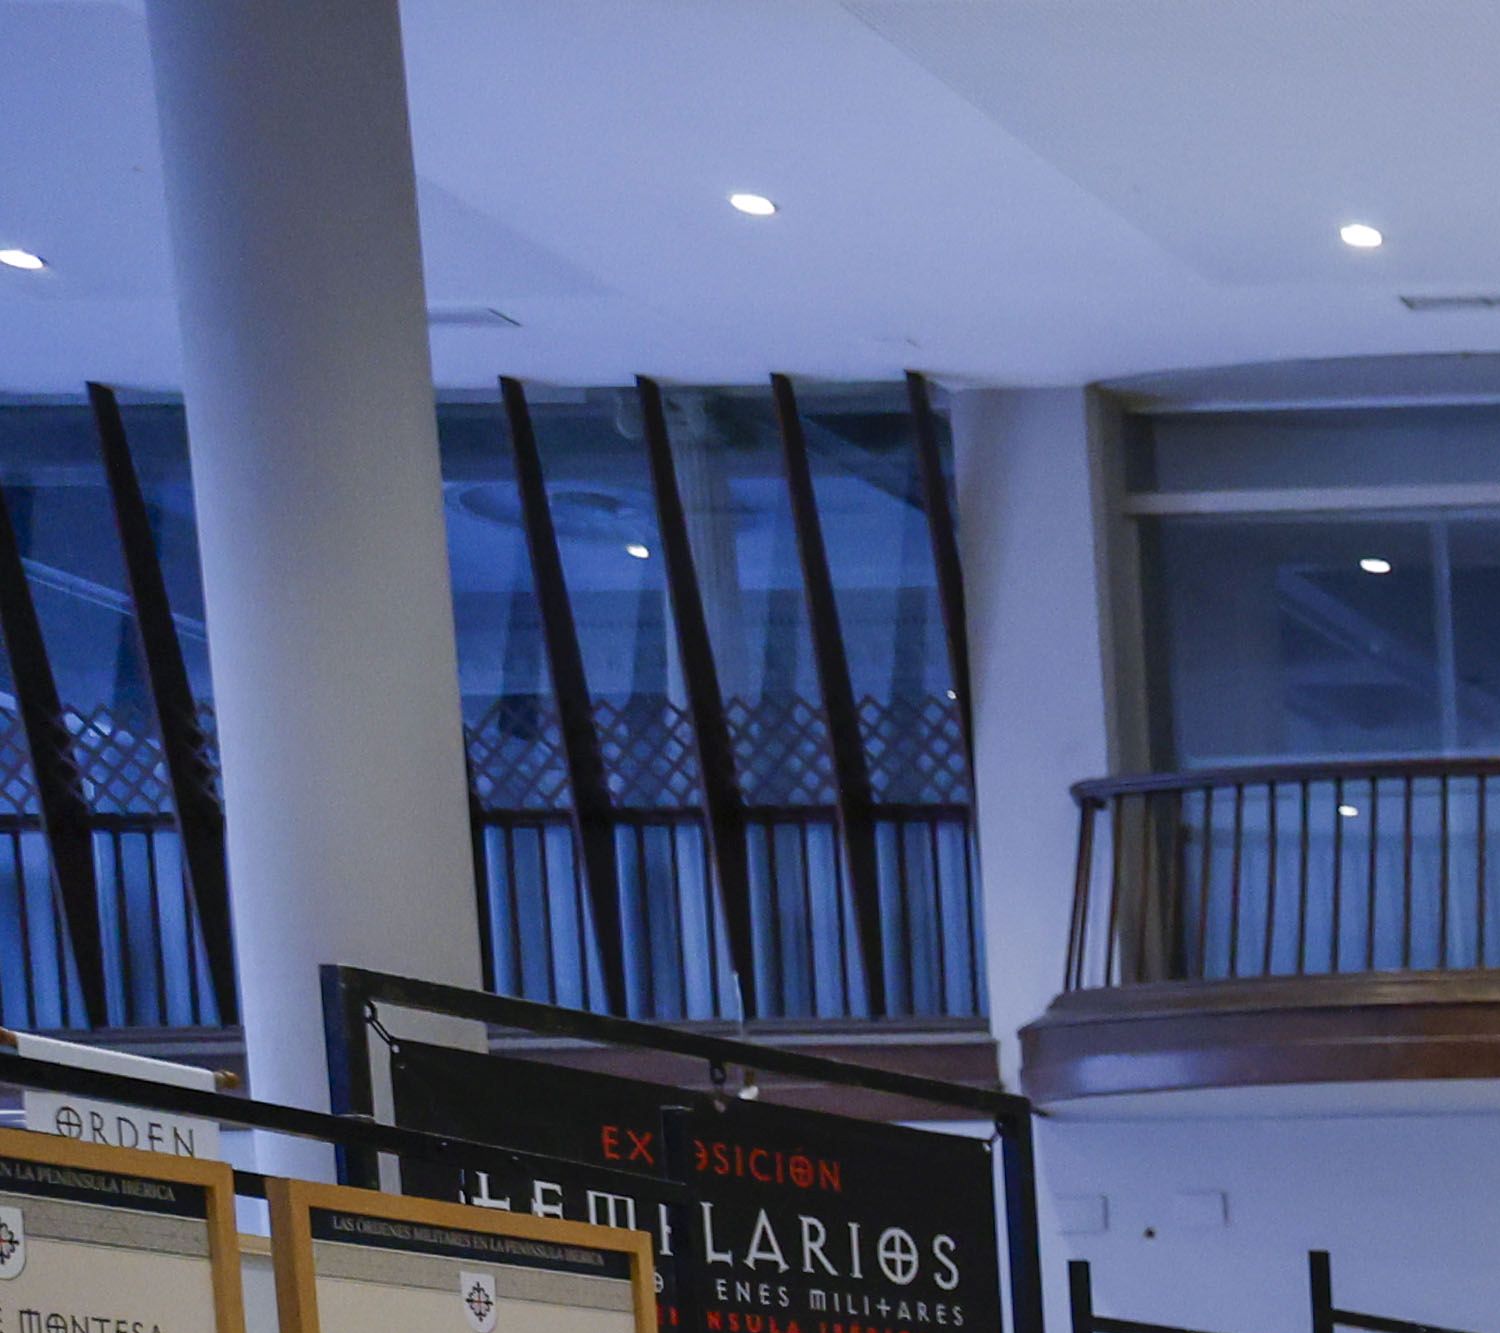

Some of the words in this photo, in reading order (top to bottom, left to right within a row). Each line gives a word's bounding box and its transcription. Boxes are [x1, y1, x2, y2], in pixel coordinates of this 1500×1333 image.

[56, 1106, 195, 1158] ORDEN
[602, 1125, 843, 1193] EXOSICIÓN
[808, 1289, 964, 1327] MILITARES
